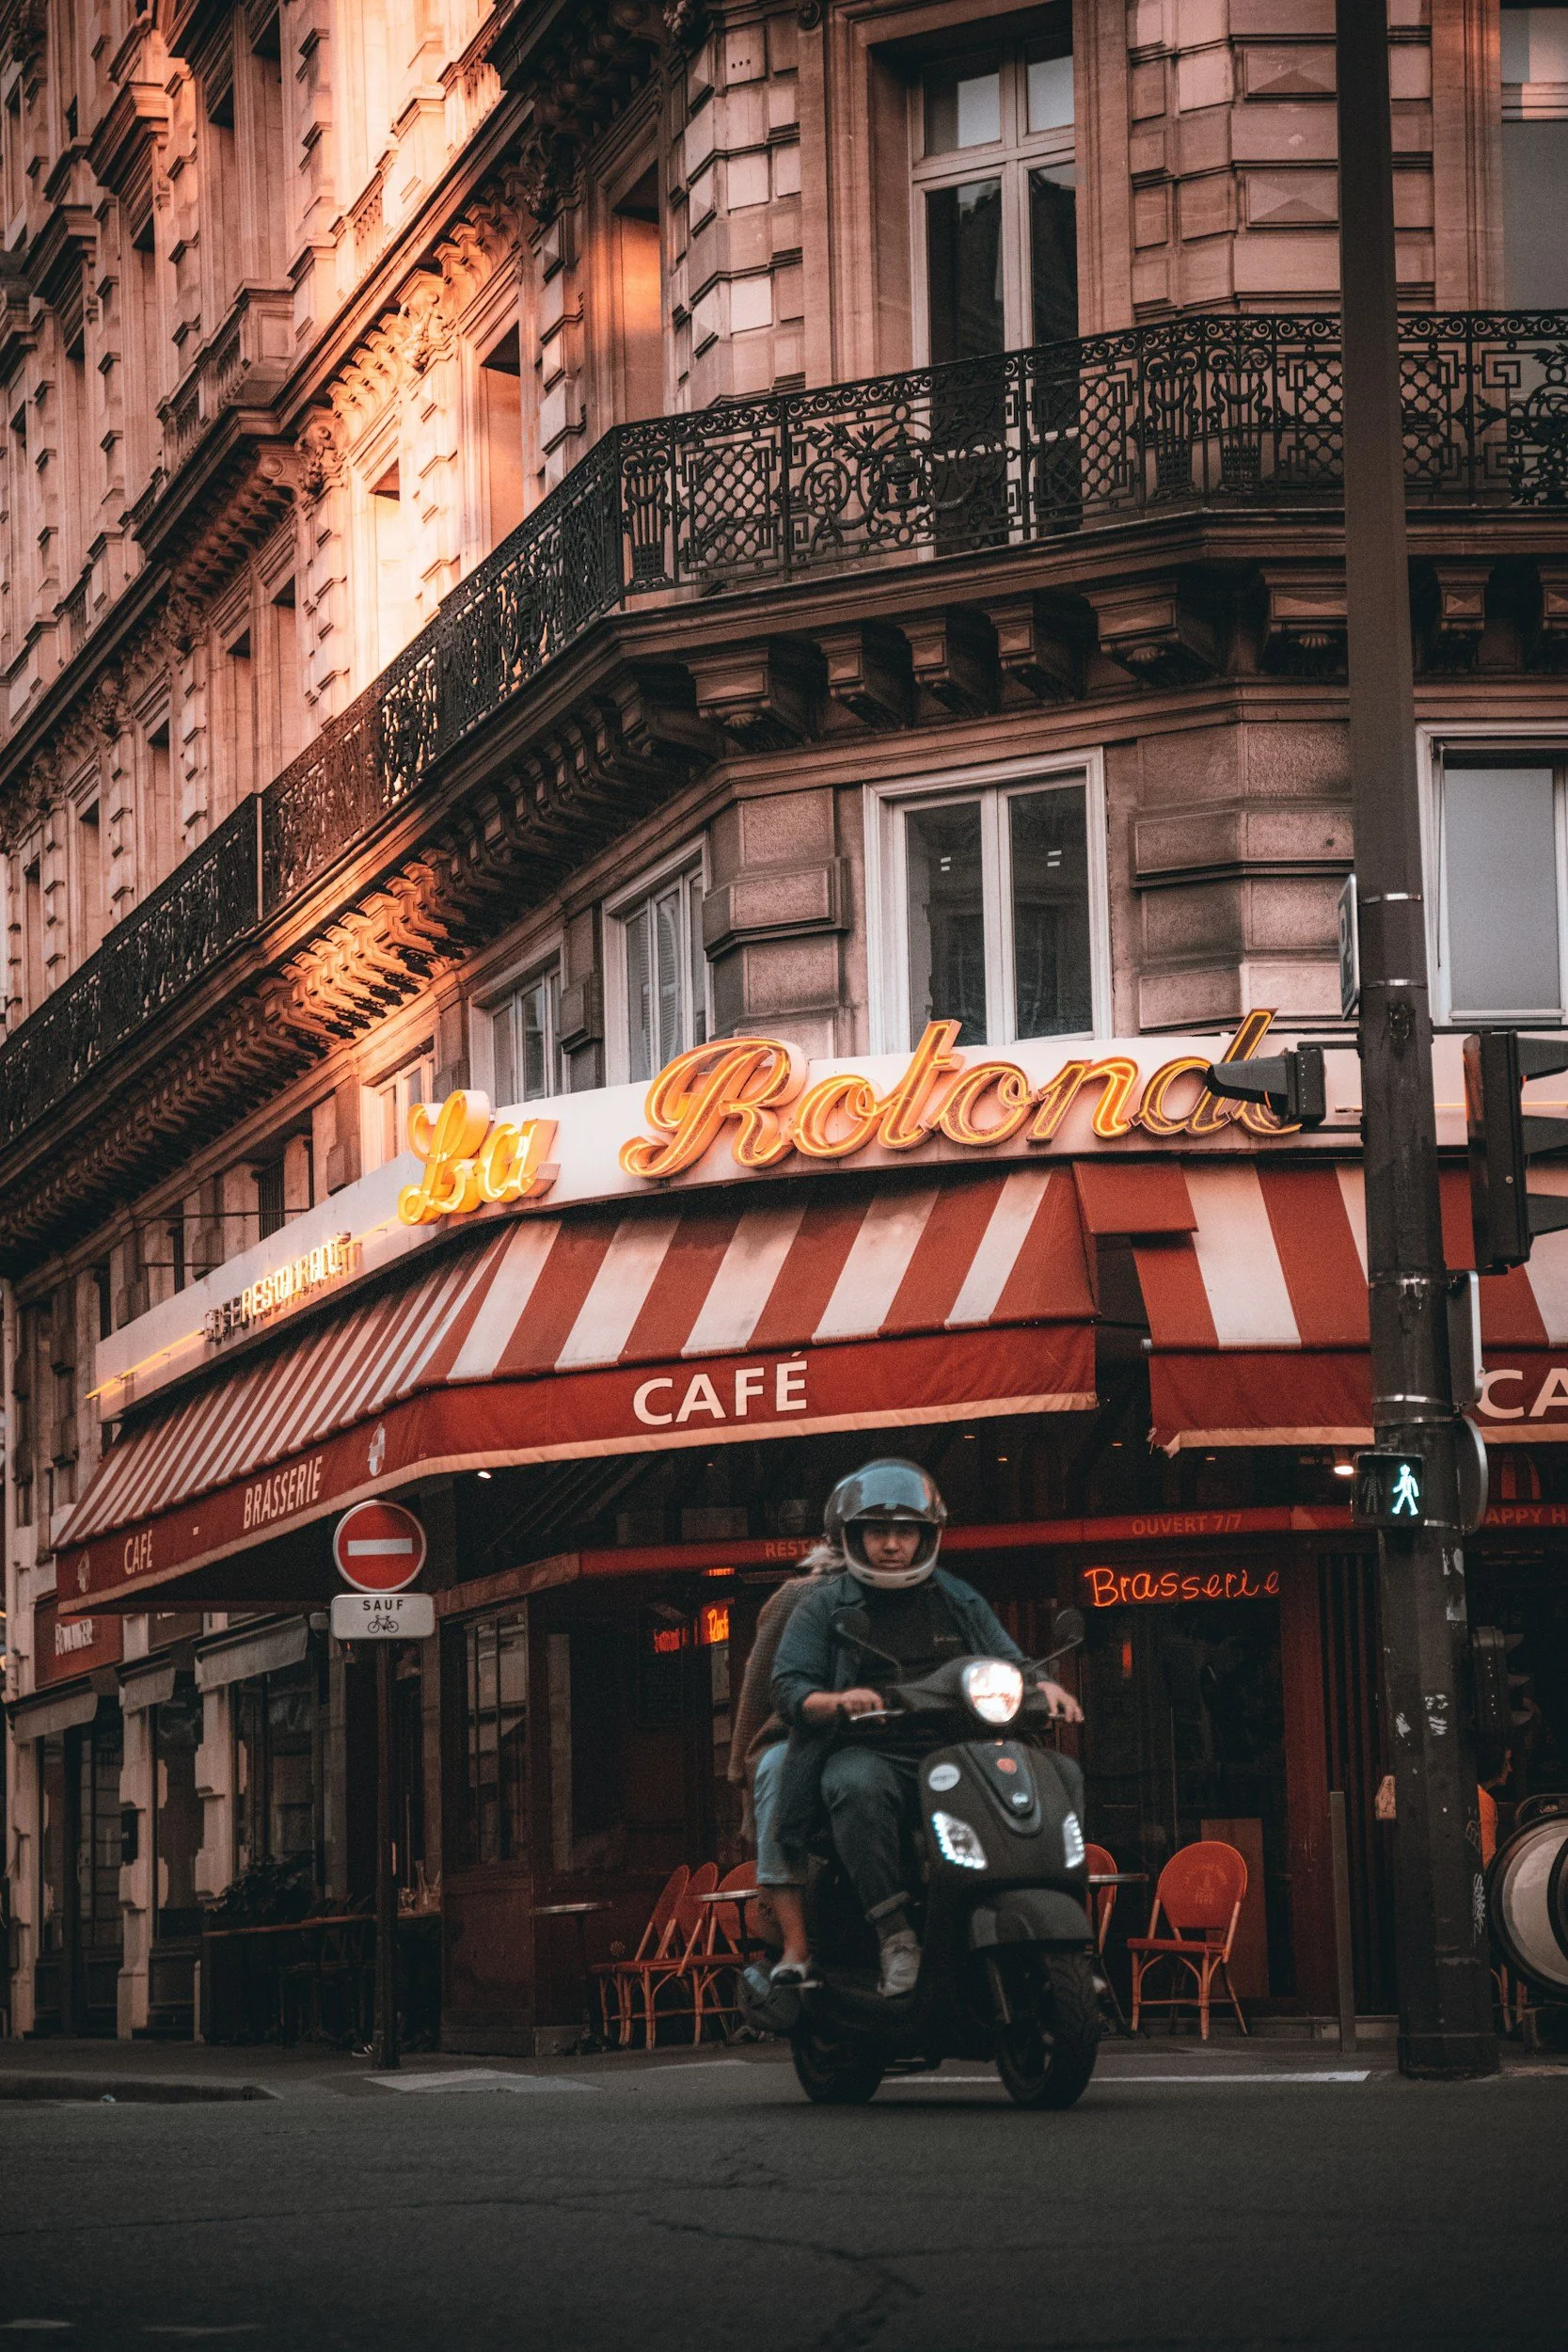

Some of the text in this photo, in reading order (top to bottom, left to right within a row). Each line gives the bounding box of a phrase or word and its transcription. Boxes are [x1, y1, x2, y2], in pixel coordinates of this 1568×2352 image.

[398, 1089, 558, 1226] La
[633, 1352, 808, 1426] CAFÉ
[1477, 1367, 1568, 1420] CA
[243, 1455, 323, 1529] BRASSERIE
[1132, 1513, 1243, 1535] OUVERT 7/7
[1485, 1507, 1544, 1526] APPY
[765, 1539, 818, 1559] REST
[362, 1599, 404, 1612] SAUF
[1085, 1567, 1280, 1608] Brasserie
